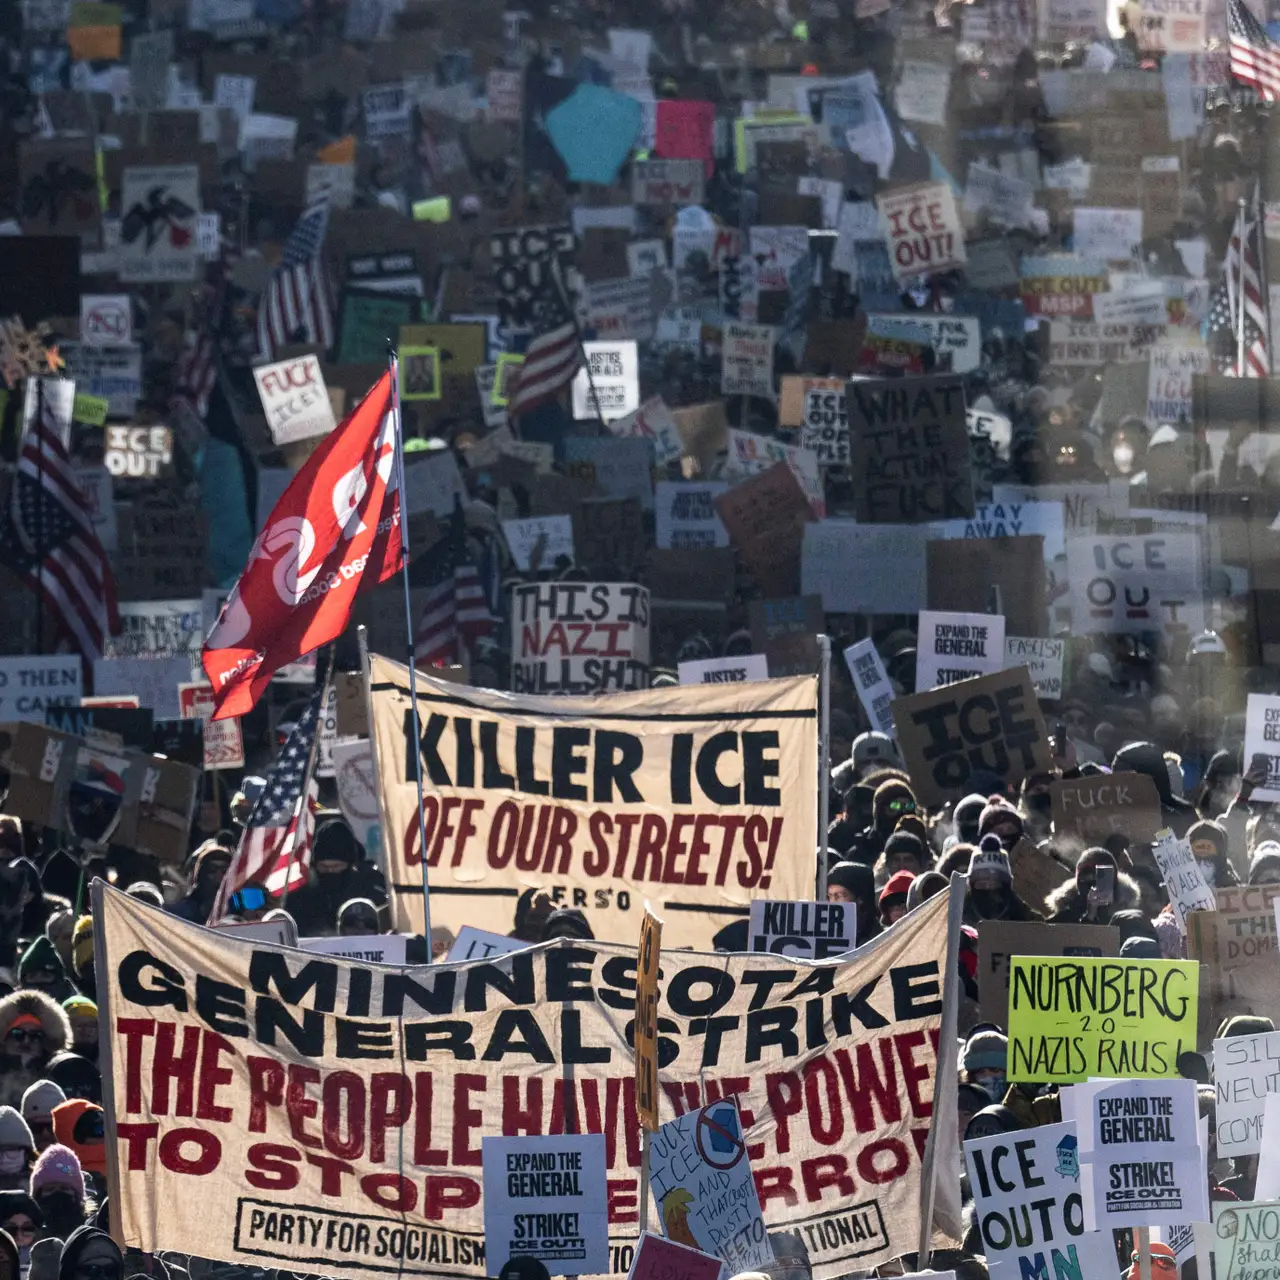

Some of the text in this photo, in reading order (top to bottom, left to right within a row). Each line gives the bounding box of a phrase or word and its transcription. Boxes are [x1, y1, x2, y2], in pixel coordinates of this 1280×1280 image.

[887, 203, 945, 238] ICE
[895, 233, 954, 267] OUT!
[261, 362, 316, 393] FUCK
[514, 587, 649, 626] THIS IS
[522, 623, 630, 656] NAZI
[934, 638, 988, 657] GENERAL
[911, 685, 1039, 761] ICE
[405, 710, 781, 806] KILLER ICE
[932, 732, 1041, 788] OUT
[1062, 784, 1133, 811] FUCK
[404, 795, 785, 889] OFF OUR STREETS!
[762, 901, 843, 938] KILLER
[118, 950, 612, 1064] GENERAL
[1012, 962, 1188, 1020] NÜRNBERG
[1080, 1016, 1114, 1034] 2.0
[1012, 1039, 1086, 1075] NAZIS
[117, 1018, 488, 1169] THE PEOPLE
[1099, 1097, 1173, 1117] EXPAND THE
[1100, 1117, 1174, 1145] GENERAL
[116, 1122, 482, 1220] TO STOP
[506, 1152, 582, 1171] EXPAND THE
[972, 1140, 1043, 1198] ICE
[1110, 1162, 1174, 1188] STRIKE!
[507, 1171, 582, 1198] GENERAL
[514, 1212, 580, 1237] STRIKE!
[509, 1238, 585, 1249] ICE OUT!
